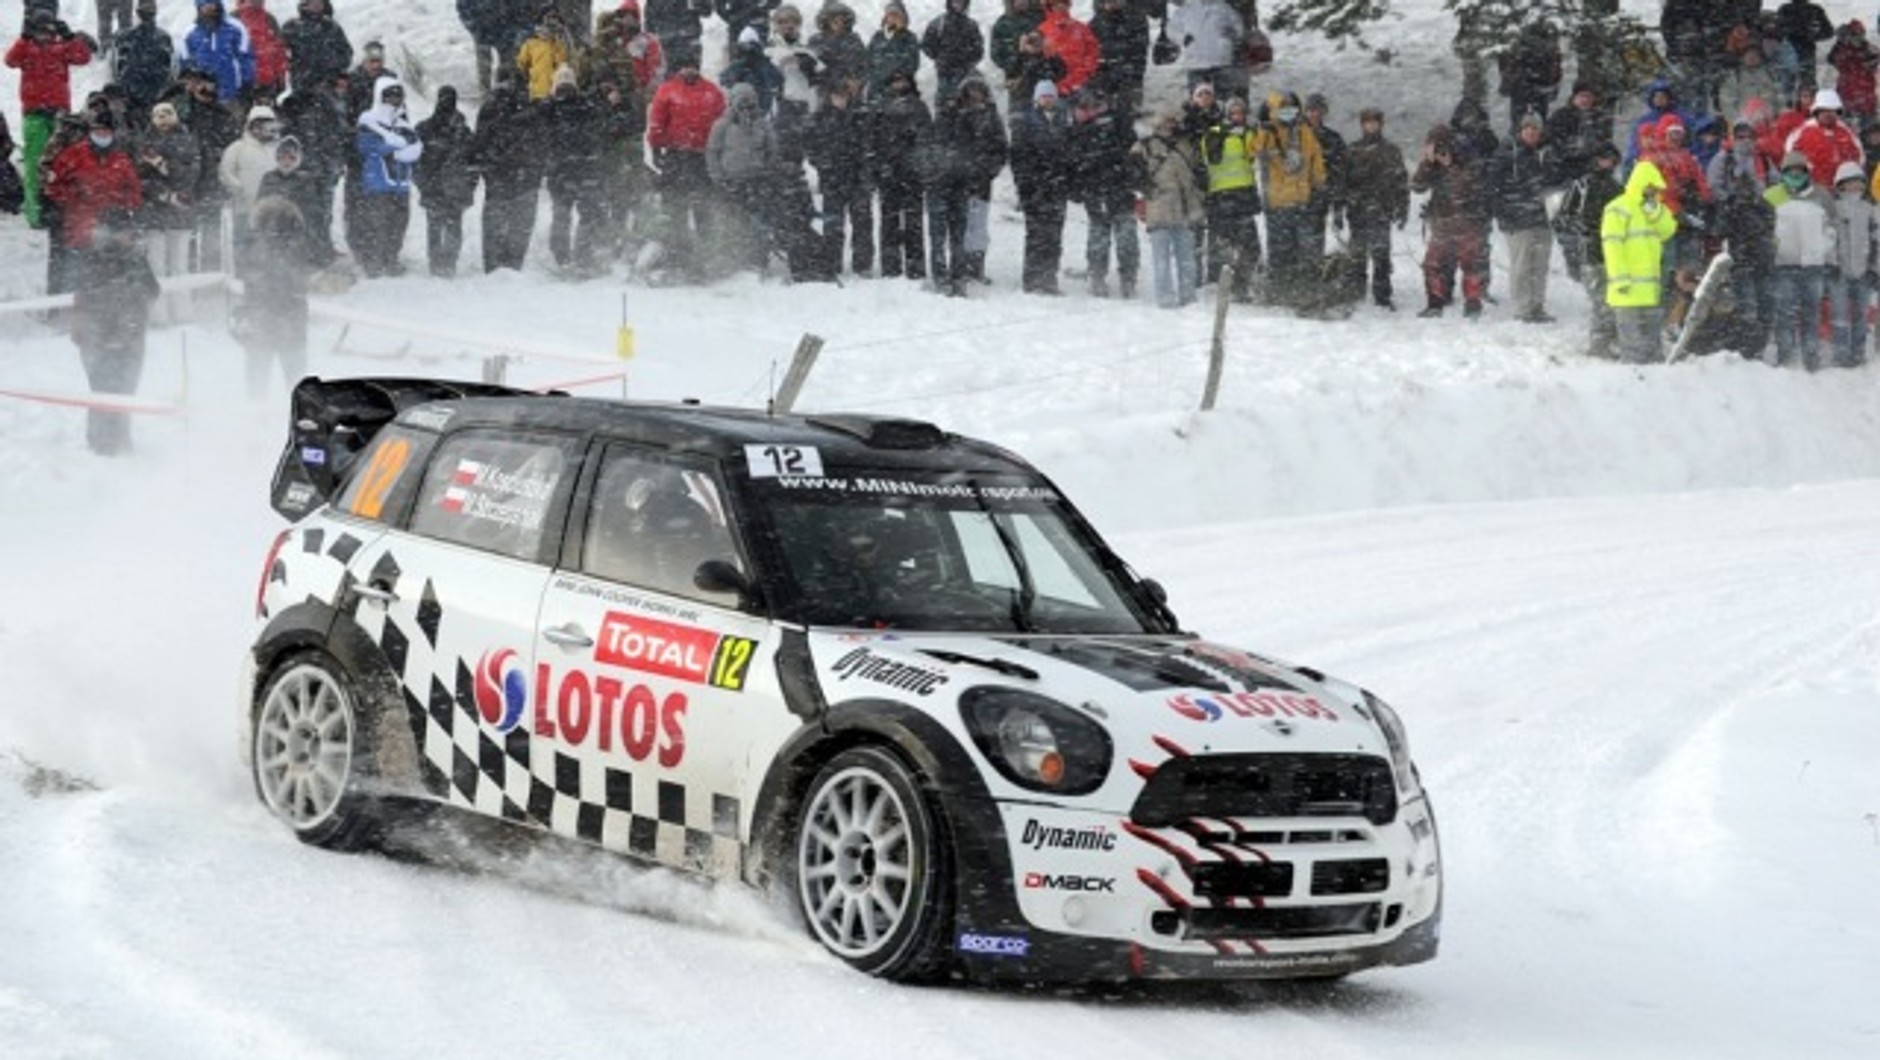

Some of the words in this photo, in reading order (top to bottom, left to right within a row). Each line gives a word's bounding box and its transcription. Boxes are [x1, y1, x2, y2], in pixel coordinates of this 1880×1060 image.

[351, 438, 411, 518] 12
[763, 446, 806, 474] 12
[605, 621, 705, 672] TOTAL
[714, 636, 752, 690] 12
[831, 645, 950, 697] Dynamic
[535, 662, 690, 769] LOTOS
[1213, 692, 1339, 722] LOTOS
[1022, 818, 1118, 852] Dynamic
